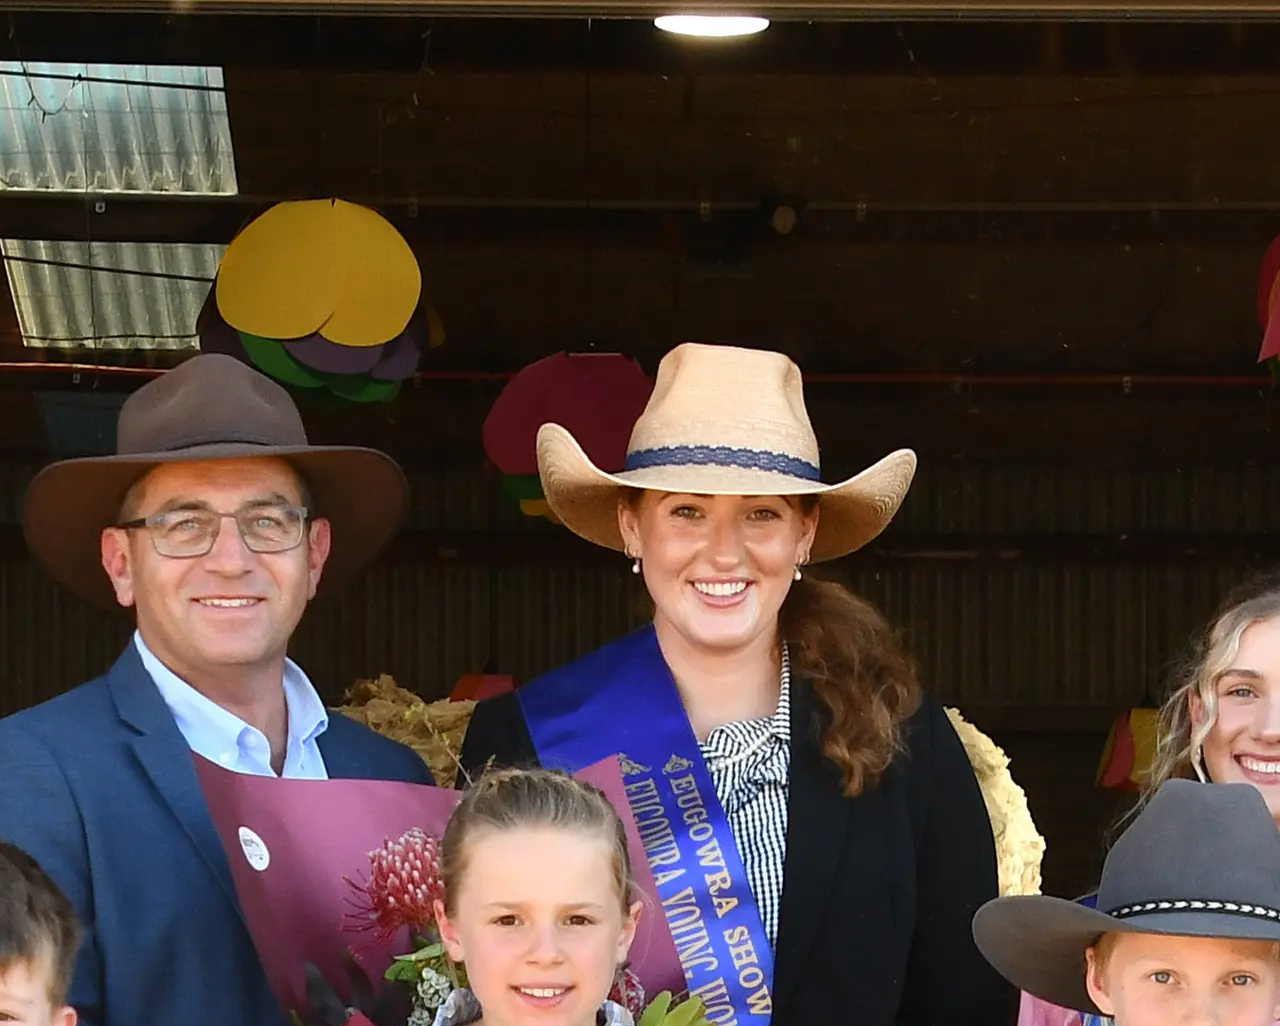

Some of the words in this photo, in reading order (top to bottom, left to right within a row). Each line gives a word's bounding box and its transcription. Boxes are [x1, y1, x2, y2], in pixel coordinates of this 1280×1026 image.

[662, 886, 719, 980] YOUNG
[672, 774, 738, 919] EUGOWRA
[723, 925, 772, 1015] SHOW
